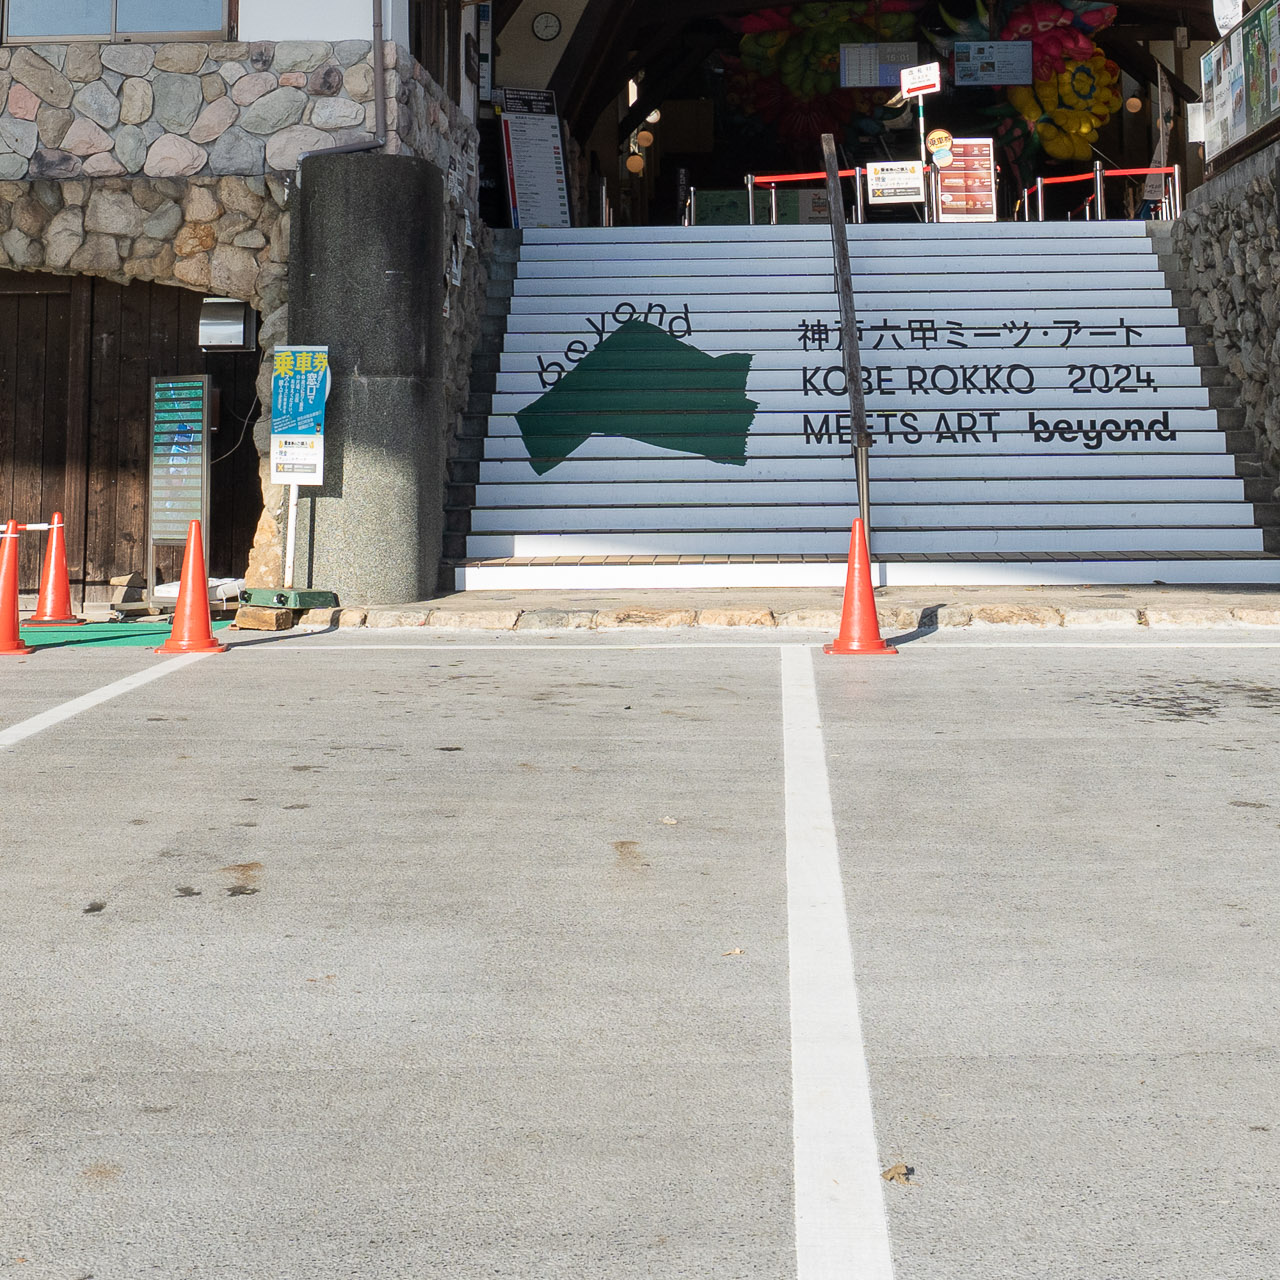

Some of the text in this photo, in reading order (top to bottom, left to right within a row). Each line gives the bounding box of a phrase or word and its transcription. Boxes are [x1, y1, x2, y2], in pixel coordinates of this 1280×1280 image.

[536, 301, 692, 389] beyond
[273, 351, 329, 377] 乗車券
[801, 363, 1158, 397] KOBE ROKKO 2024
[934, 412, 1001, 444] ART
[1028, 410, 1177, 450] beyond
